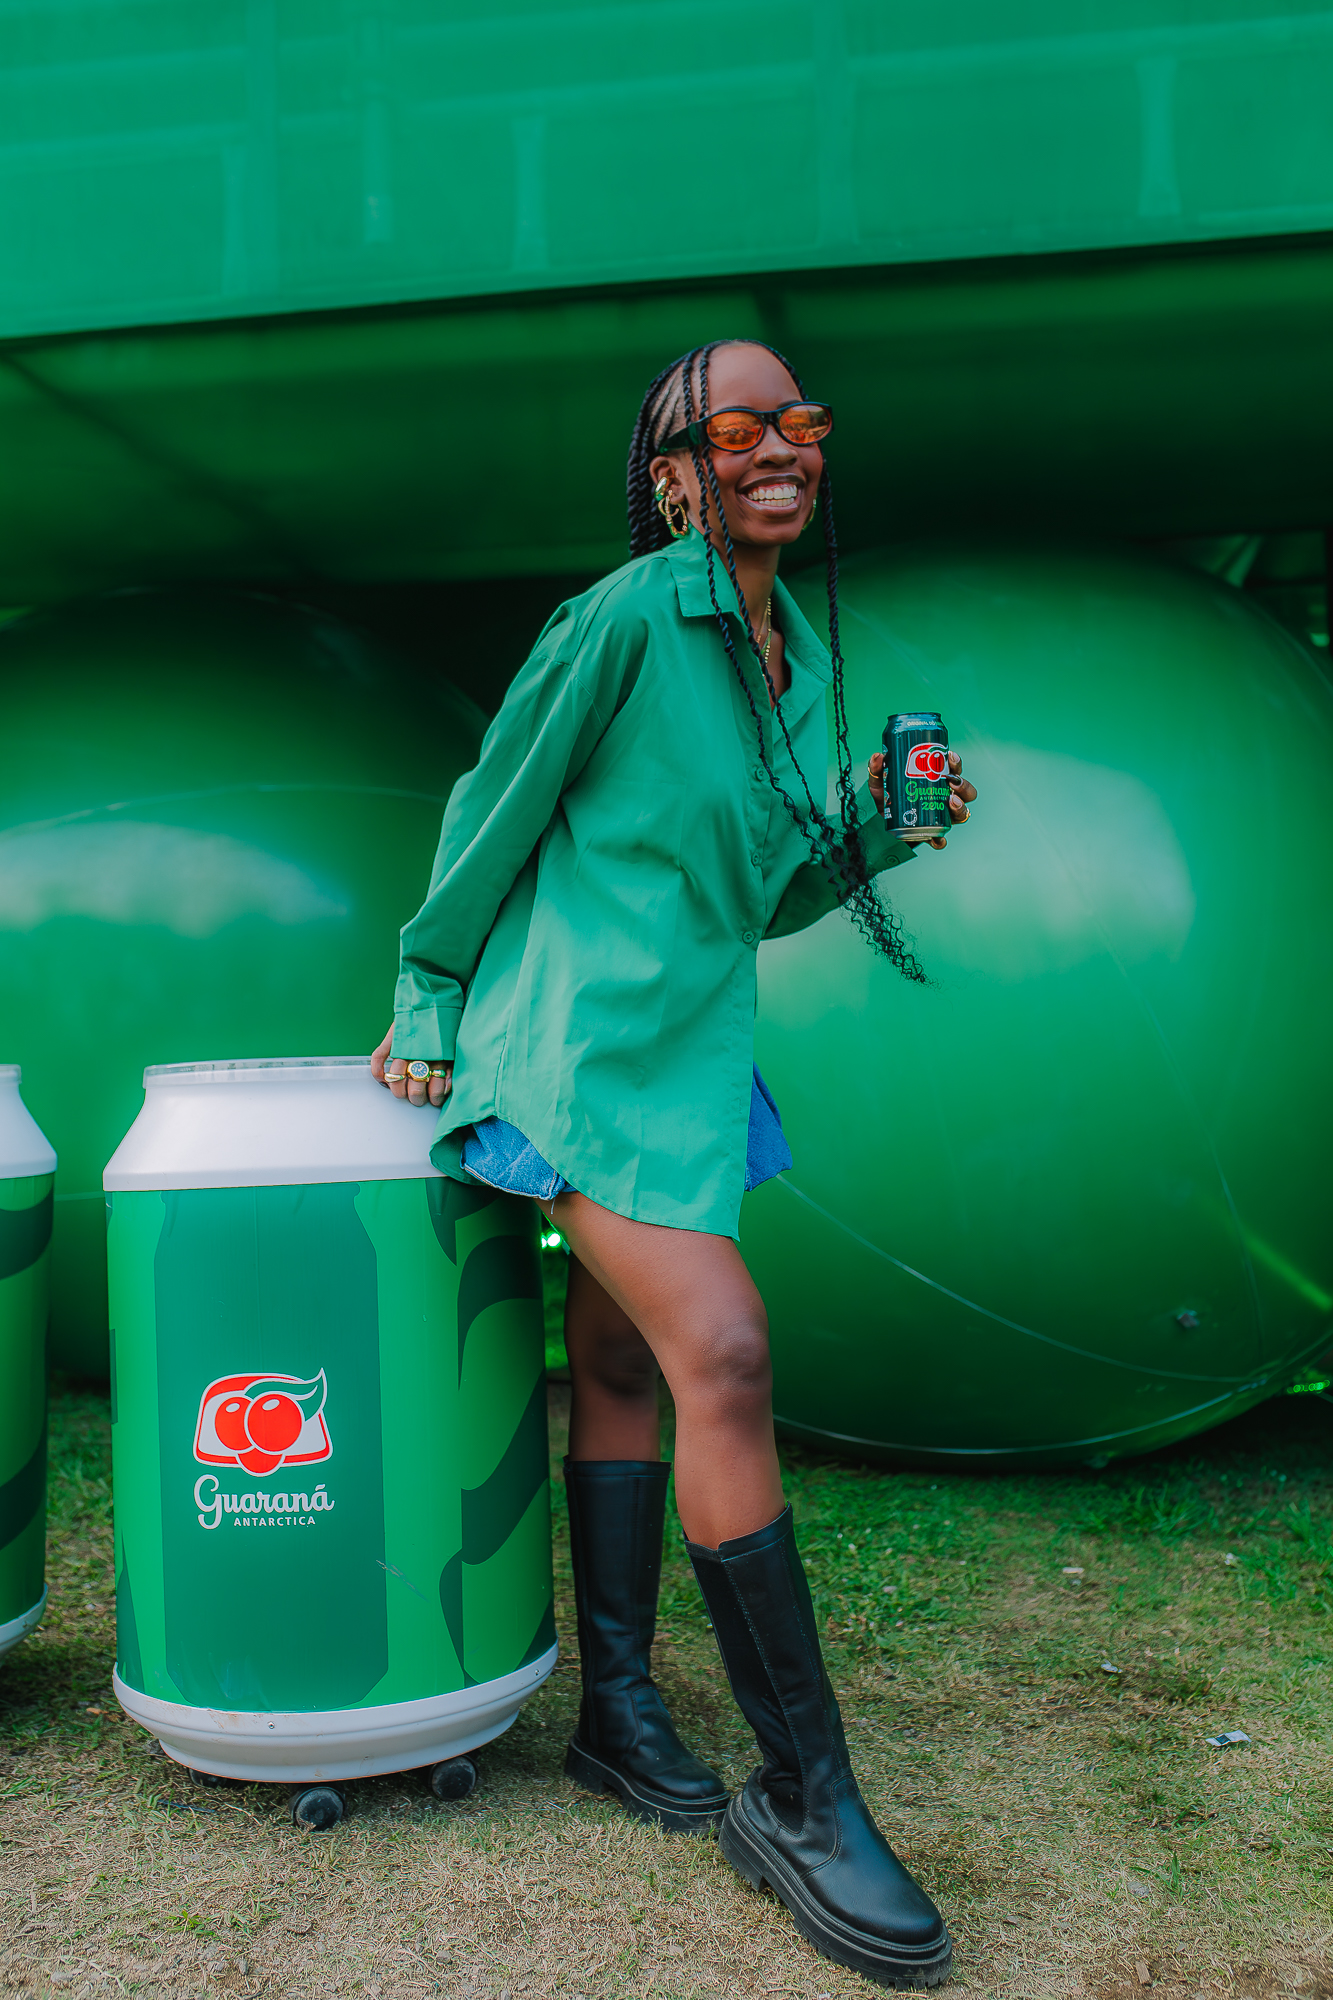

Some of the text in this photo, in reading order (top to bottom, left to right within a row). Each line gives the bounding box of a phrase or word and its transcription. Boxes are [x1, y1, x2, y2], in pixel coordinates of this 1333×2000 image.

[922, 801, 945, 811] zero
[194, 1474, 335, 1529] Guaraná
[233, 1516, 316, 1526] ANTARCTICA
